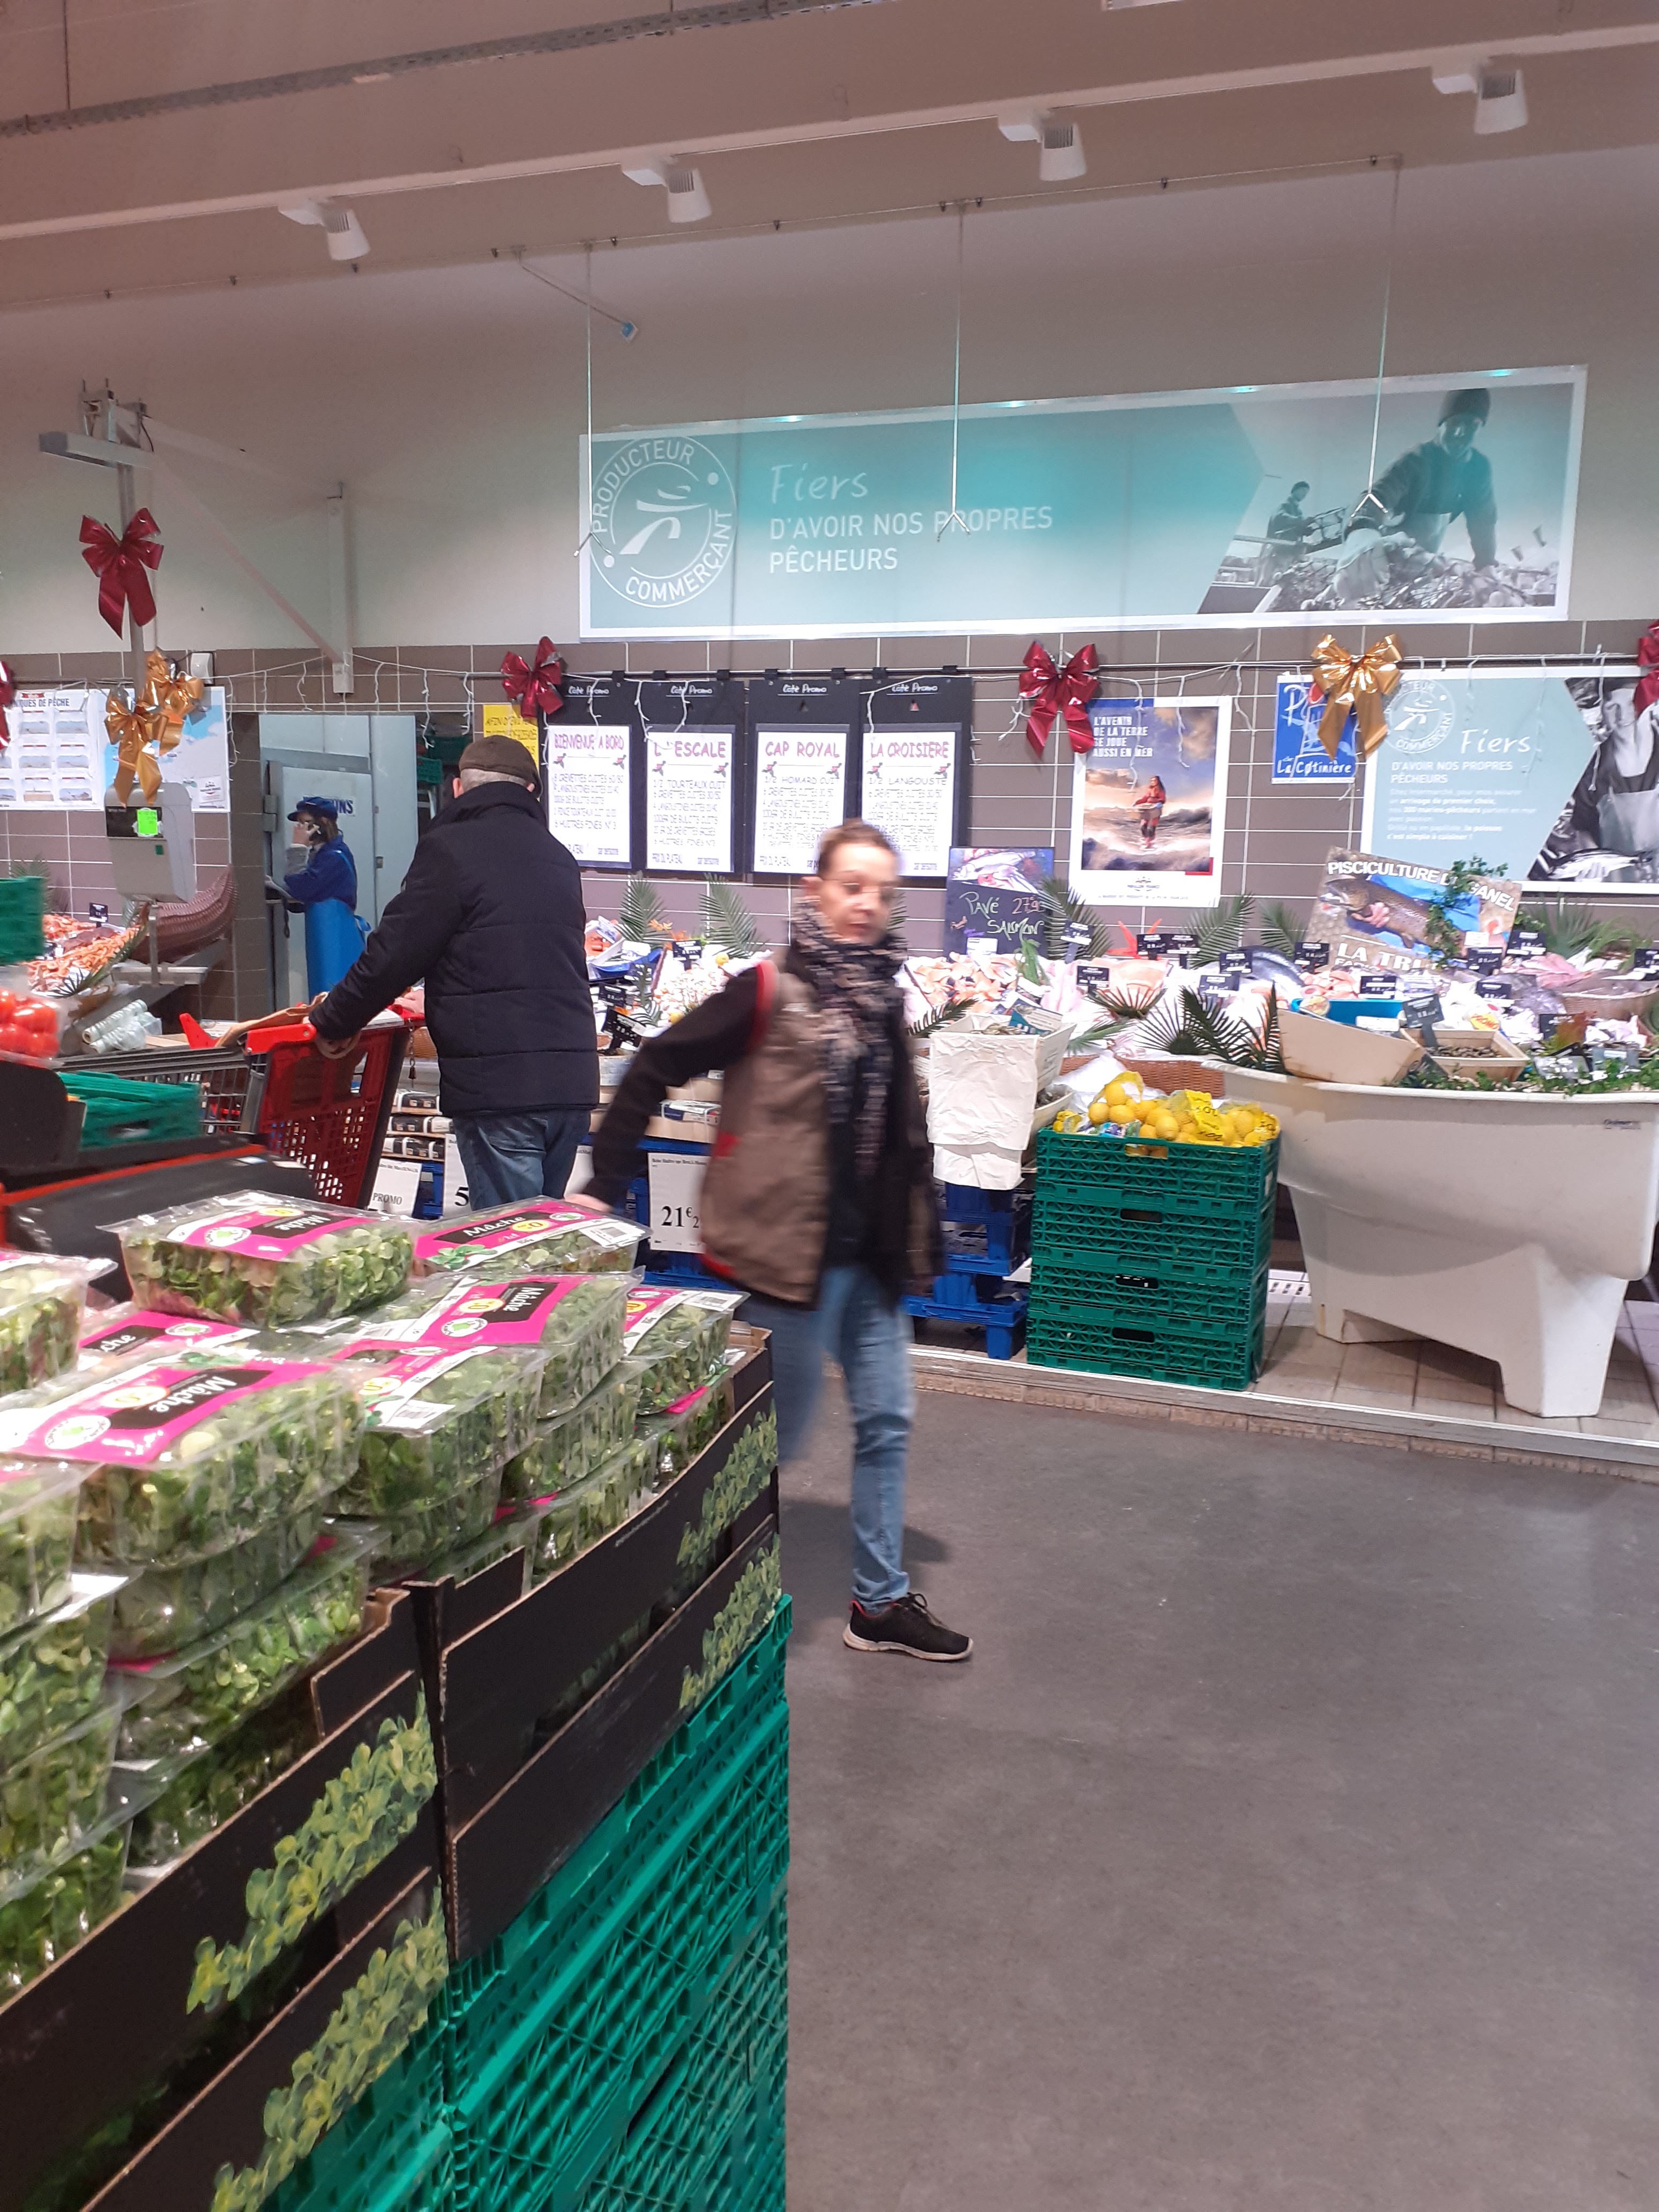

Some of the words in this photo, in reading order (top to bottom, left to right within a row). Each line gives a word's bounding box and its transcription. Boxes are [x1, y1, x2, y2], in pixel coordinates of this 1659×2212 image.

[592, 438, 696, 533] PRODUCTEUR
[770, 464, 869, 504] Fiers
[770, 514, 865, 541] D'AVOIR
[873, 512, 924, 536] NOS
[934, 506, 1053, 534] PROPRES
[624, 510, 734, 603] COMMERÇANT
[770, 545, 899, 574] PÊCHEURS
[1094, 716, 1132, 726] L'AVENIR
[1094, 727, 1105, 736] DE
[1107, 727, 1118, 736] LA
[1120, 727, 1148, 736] TERRE
[554, 734, 595, 750] BIENVENUE
[606, 735, 624, 750] BORD
[765, 741, 789, 757] CAP
[797, 742, 840, 758] ROYAL
[871, 743, 884, 758] LA
[1106, 738, 1127, 748] JOUE
[1461, 729, 1531, 754] Fiers
[1092, 748, 1118, 757] AUSSI
[1120, 748, 1132, 758] EN
[1134, 748, 1154, 757] MER
[1277, 759, 1292, 774] La
[1295, 757, 1352, 776] Cotinière
[1436, 761, 1459, 771] NOS
[1463, 761, 1513, 771] PROPRES
[1391, 773, 1448, 784] PÊCHEURS
[1328, 861, 1440, 884] PISCICULTURE
[1337, 943, 1367, 962] LA
[372, 1192, 402, 1206] PROMO
[463, 1215, 526, 1237] Mâche
[503, 1287, 545, 1312] Mâche
[149, 1376, 237, 1414] Mâche
